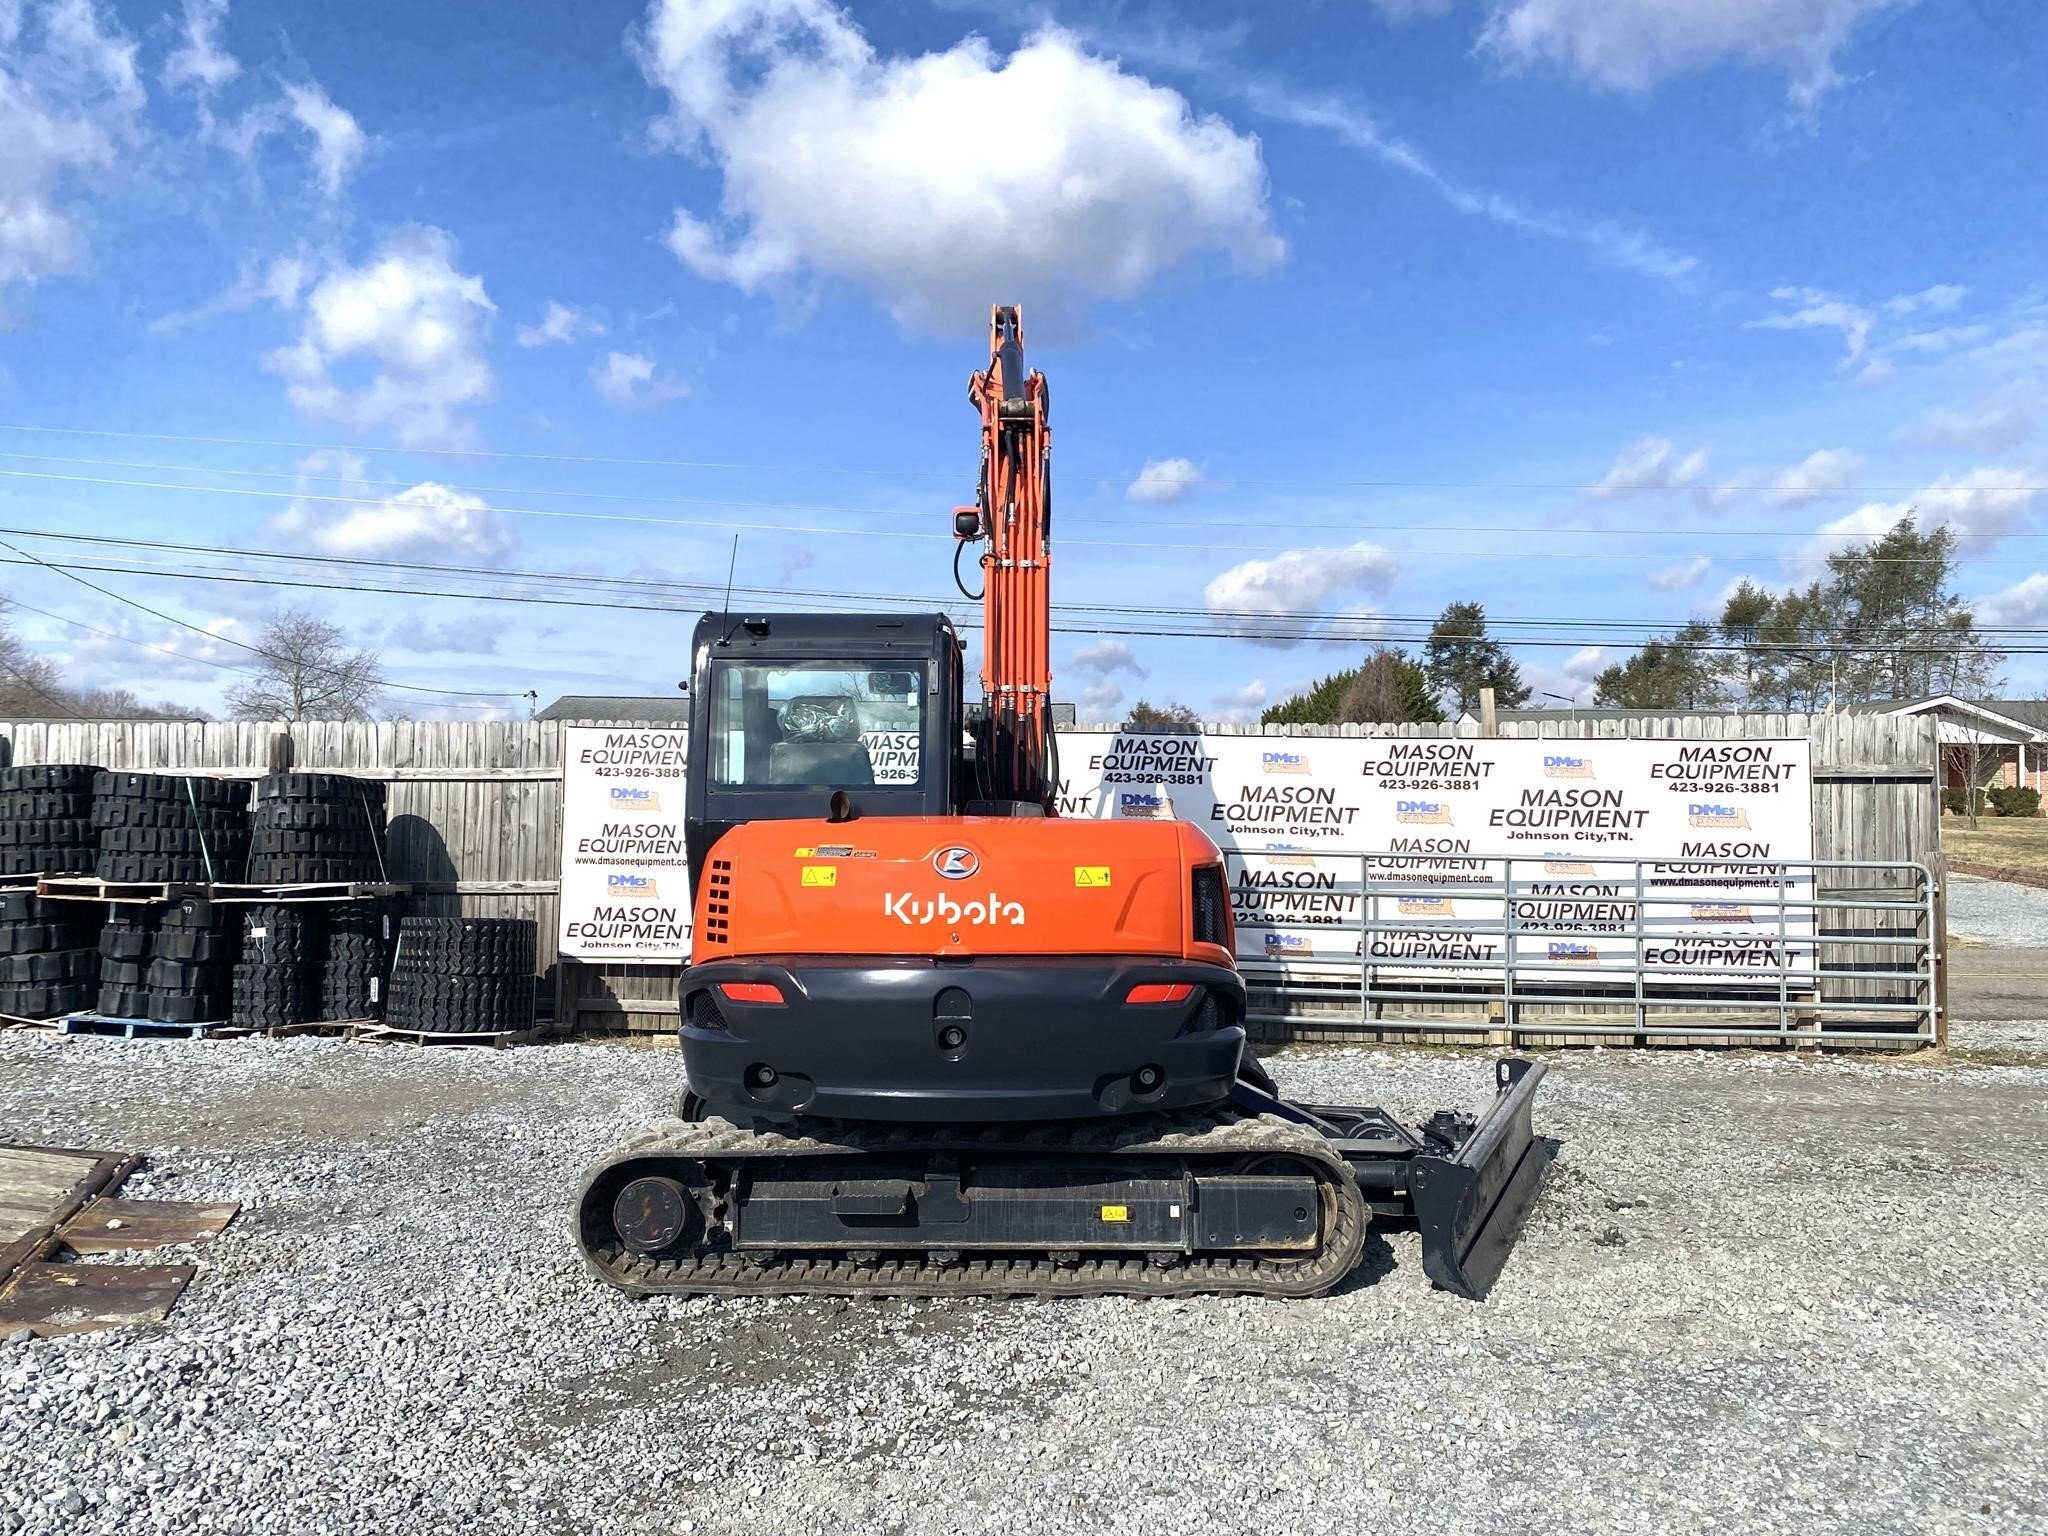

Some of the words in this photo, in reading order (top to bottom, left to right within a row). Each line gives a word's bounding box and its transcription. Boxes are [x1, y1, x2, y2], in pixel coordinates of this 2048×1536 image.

[605, 734, 684, 749] MASON
[861, 735, 920, 750] MASO
[1114, 739, 1198, 755] MASON
[580, 749, 688, 765] EQUIPMEN
[1388, 745, 1474, 760] MASON
[1678, 747, 1773, 762] MASON
[1089, 755, 1218, 772] EQUIPMENT
[1362, 761, 1495, 777] EQUIPMENT
[1650, 763, 1797, 780] EQUIPMENT
[1104, 773, 1203, 785] 423-926-3881
[1378, 779, 1479, 790] 423-926-3881
[1240, 785, 1335, 804] MASON
[1668, 782, 1779, 793] 423-926-3881
[1520, 789, 1623, 808] MASON
[1210, 803, 1359, 824] EQUIPMENT
[1488, 808, 1650, 828] EQUIPMENT
[601, 824, 676, 838] MASON
[1226, 824, 1285, 835] Johnson
[1506, 830, 1569, 840] Johnson
[578, 839, 687, 854] EQUIPMEN
[1389, 838, 1471, 853] MASON
[1681, 842, 1770, 858] MASON
[574, 856, 688, 868] www.dmasonequipment.co
[1238, 870, 1336, 889] MASON
[1650, 877, 1795, 890] www.dmasonequipment.cm
[884, 892, 1025, 925] Kubota
[1231, 892, 1357, 912] QUIPMENT
[593, 906, 676, 922] MASON
[566, 923, 693, 939] EQUIPMENT
[580, 940, 632, 949] Johnson
[1644, 948, 1801, 967] EQUIPMENT
